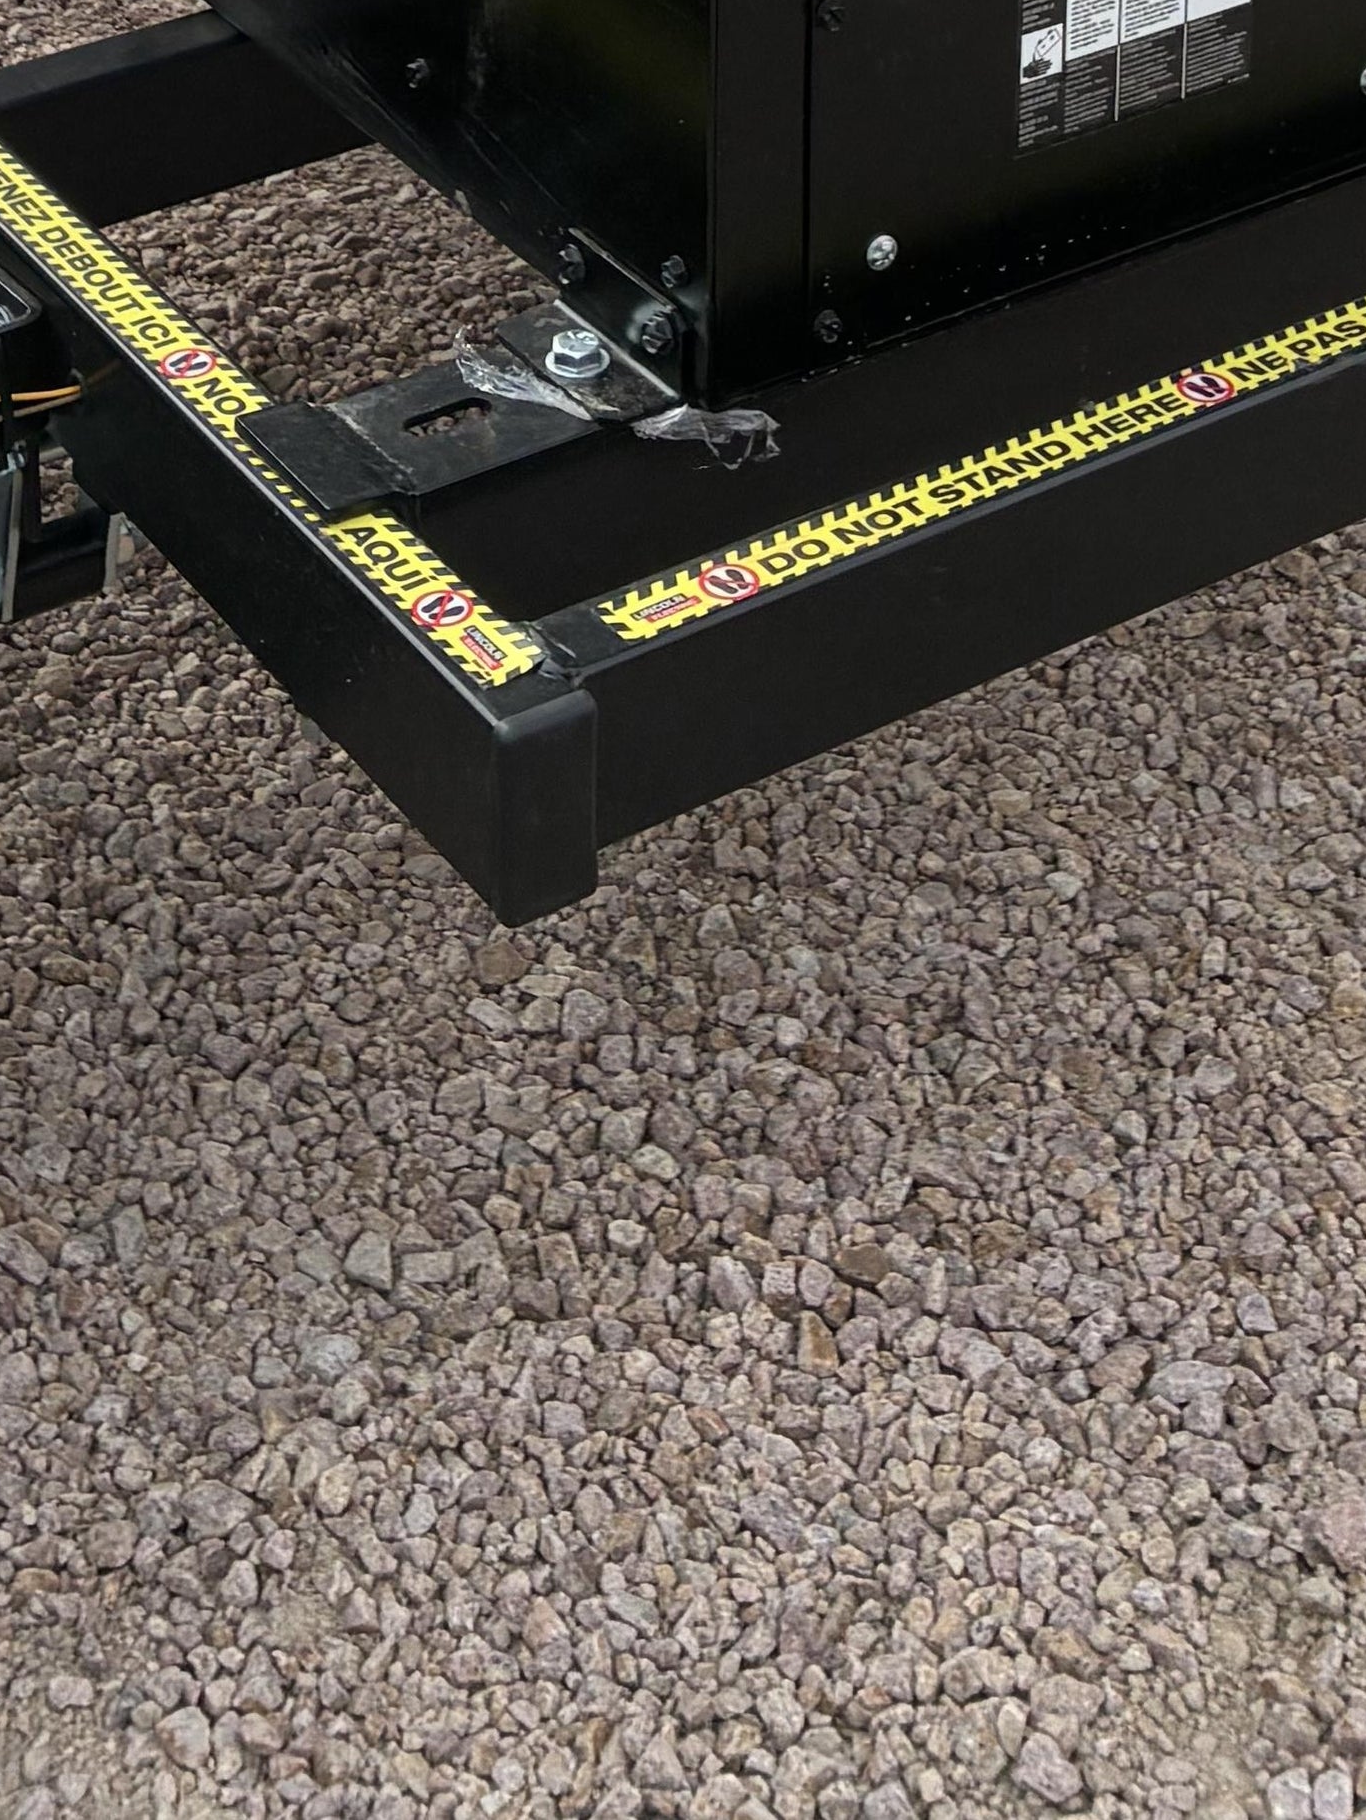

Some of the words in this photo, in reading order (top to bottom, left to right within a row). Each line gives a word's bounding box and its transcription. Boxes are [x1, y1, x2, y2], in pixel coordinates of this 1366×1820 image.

[37, 225, 145, 325] DEBOUT
[133, 315, 181, 350] ICI
[194, 375, 247, 415] NO
[1234, 356, 1283, 384] NE
[758, 537, 831, 576] DO
[835, 499, 924, 548] NOT
[934, 440, 1072, 505] STAND
[1073, 394, 1184, 446] HERE
